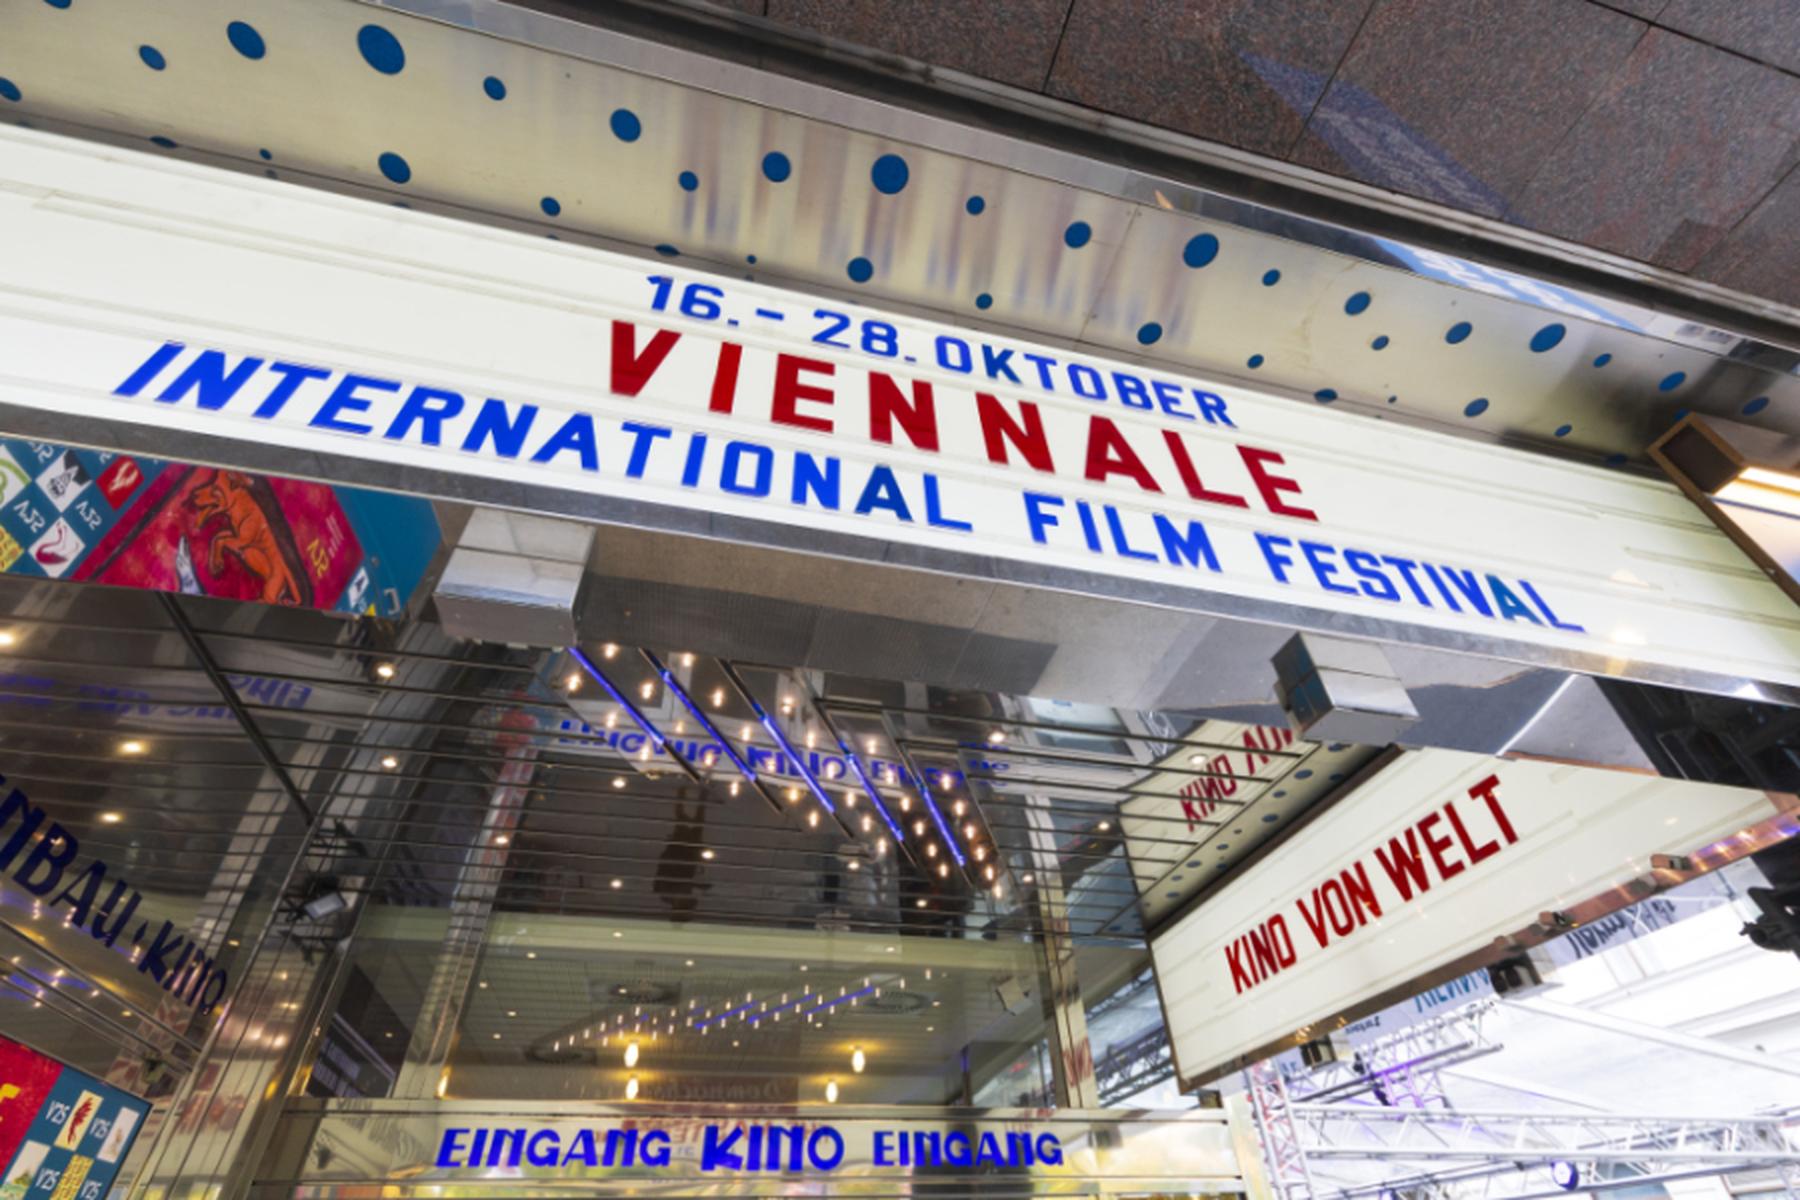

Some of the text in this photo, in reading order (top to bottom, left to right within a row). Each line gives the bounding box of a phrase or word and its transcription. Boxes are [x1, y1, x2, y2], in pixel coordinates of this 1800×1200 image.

[610, 319, 1317, 522] VIENNALE
[934, 335, 1238, 427] OKTOBER
[112, 341, 1586, 634] INTERNATIONAL FILM FESTIVAL
[1224, 774, 1519, 995] KINO VON WELT
[436, 1128, 672, 1168] EINGANG
[700, 1124, 846, 1172] KINO
[873, 1130, 1064, 1168] EINGANG
